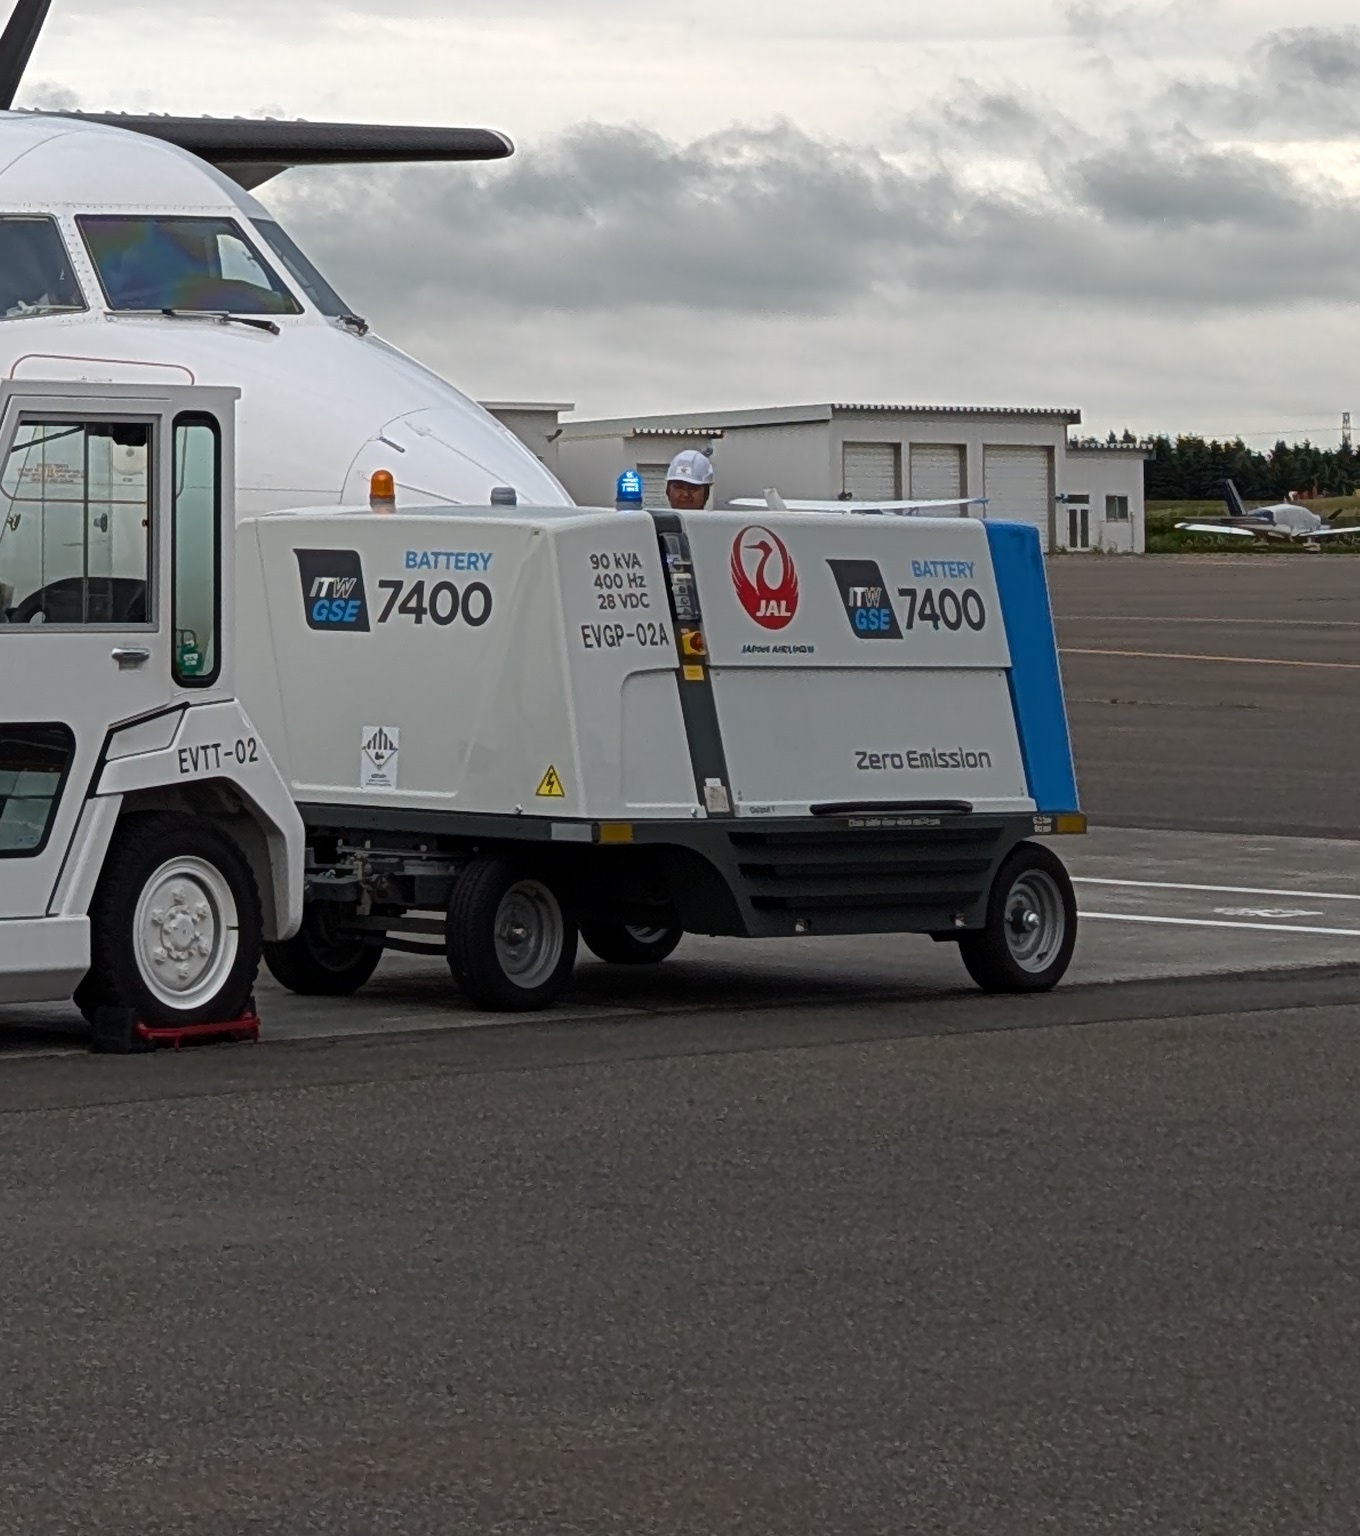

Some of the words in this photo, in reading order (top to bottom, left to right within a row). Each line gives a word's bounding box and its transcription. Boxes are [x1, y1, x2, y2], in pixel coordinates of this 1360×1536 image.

[405, 551, 494, 571] BATTERY
[589, 553, 611, 570] 90
[613, 552, 642, 570] kVA
[911, 560, 976, 579] BATTERY
[309, 576, 357, 600] ITW
[594, 573, 624, 590] 400
[627, 572, 647, 588] Hz
[377, 580, 493, 627] 7400
[597, 593, 617, 610] 28
[617, 592, 651, 609] VDC
[755, 599, 792, 617] JAL
[848, 586, 883, 609] ITW
[312, 599, 361, 622] GSE
[855, 608, 891, 631] GSE
[897, 587, 986, 632] 7400
[581, 622, 670, 649] EVGP-02A
[178, 737, 259, 774] EVTT-02
[855, 750, 904, 770] Zero
[906, 746, 992, 769] Emission
